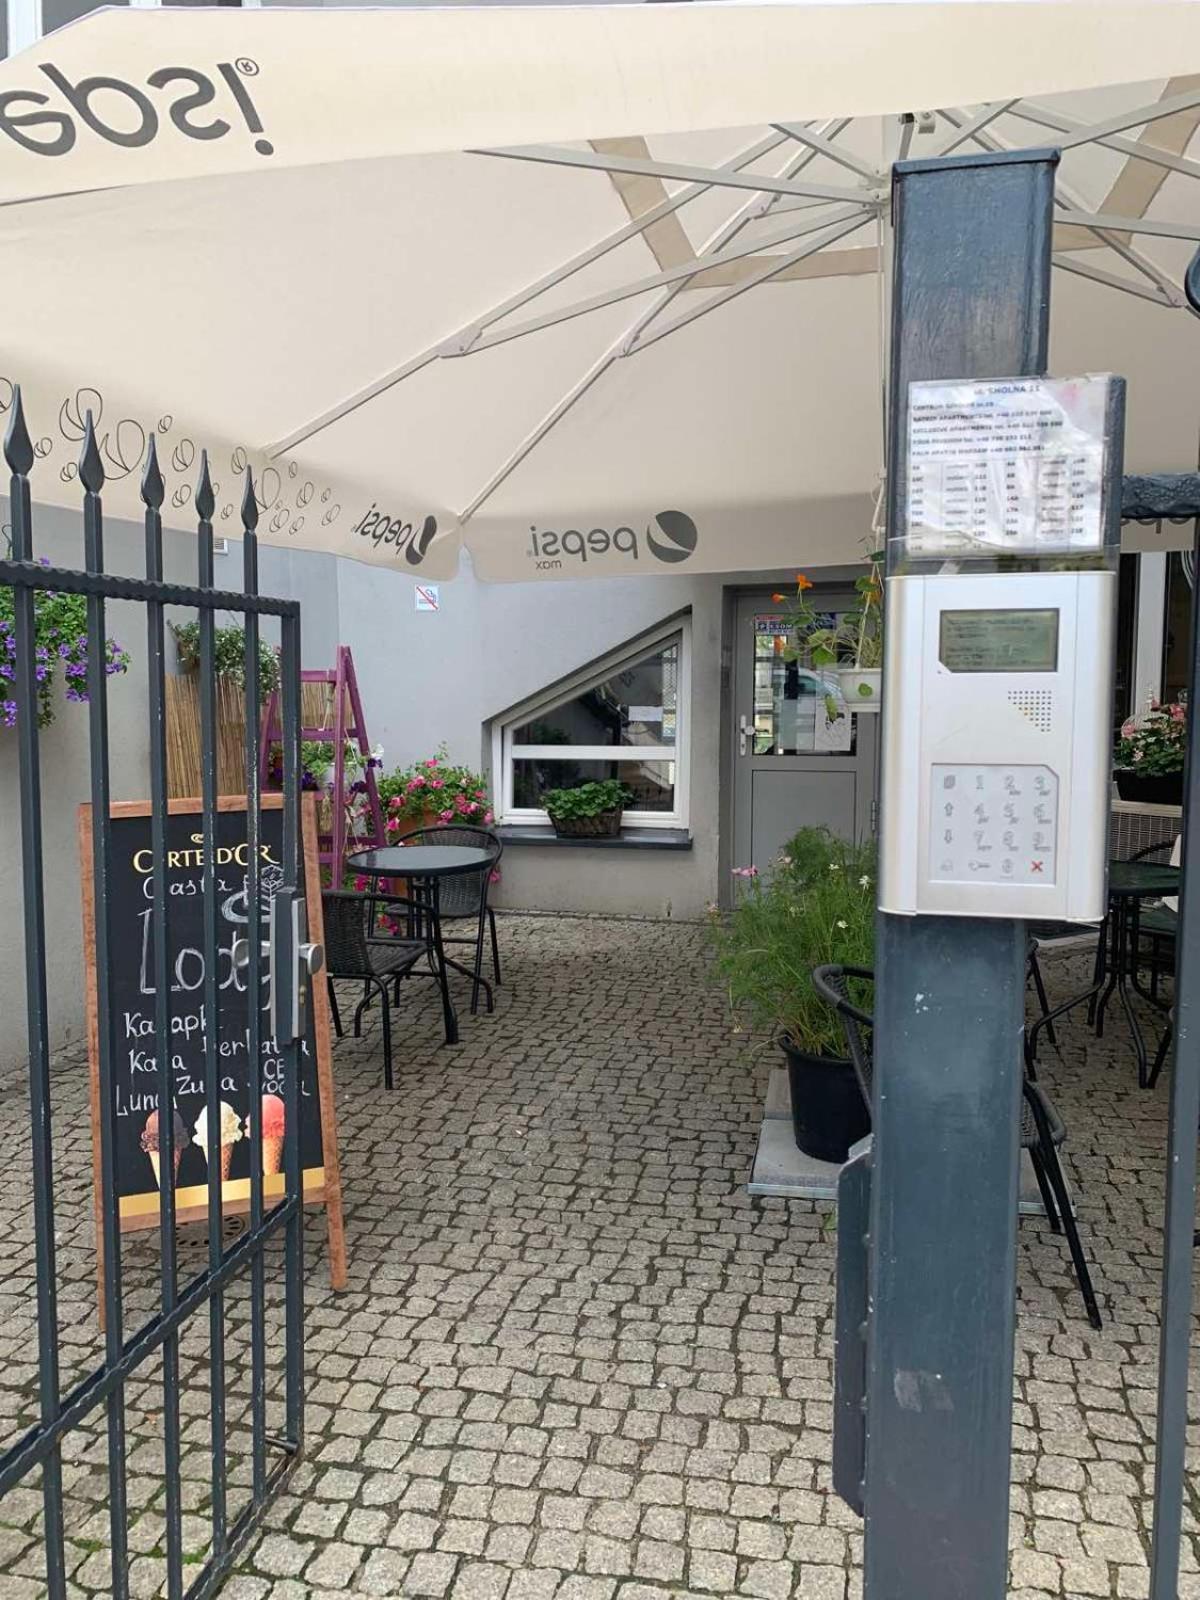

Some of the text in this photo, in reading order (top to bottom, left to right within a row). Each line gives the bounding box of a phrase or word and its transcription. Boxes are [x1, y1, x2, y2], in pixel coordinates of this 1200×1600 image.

[133, 848, 205, 874] CRTE
[128, 1049, 188, 1075] Kaa
[176, 1075, 239, 1096] Zua
